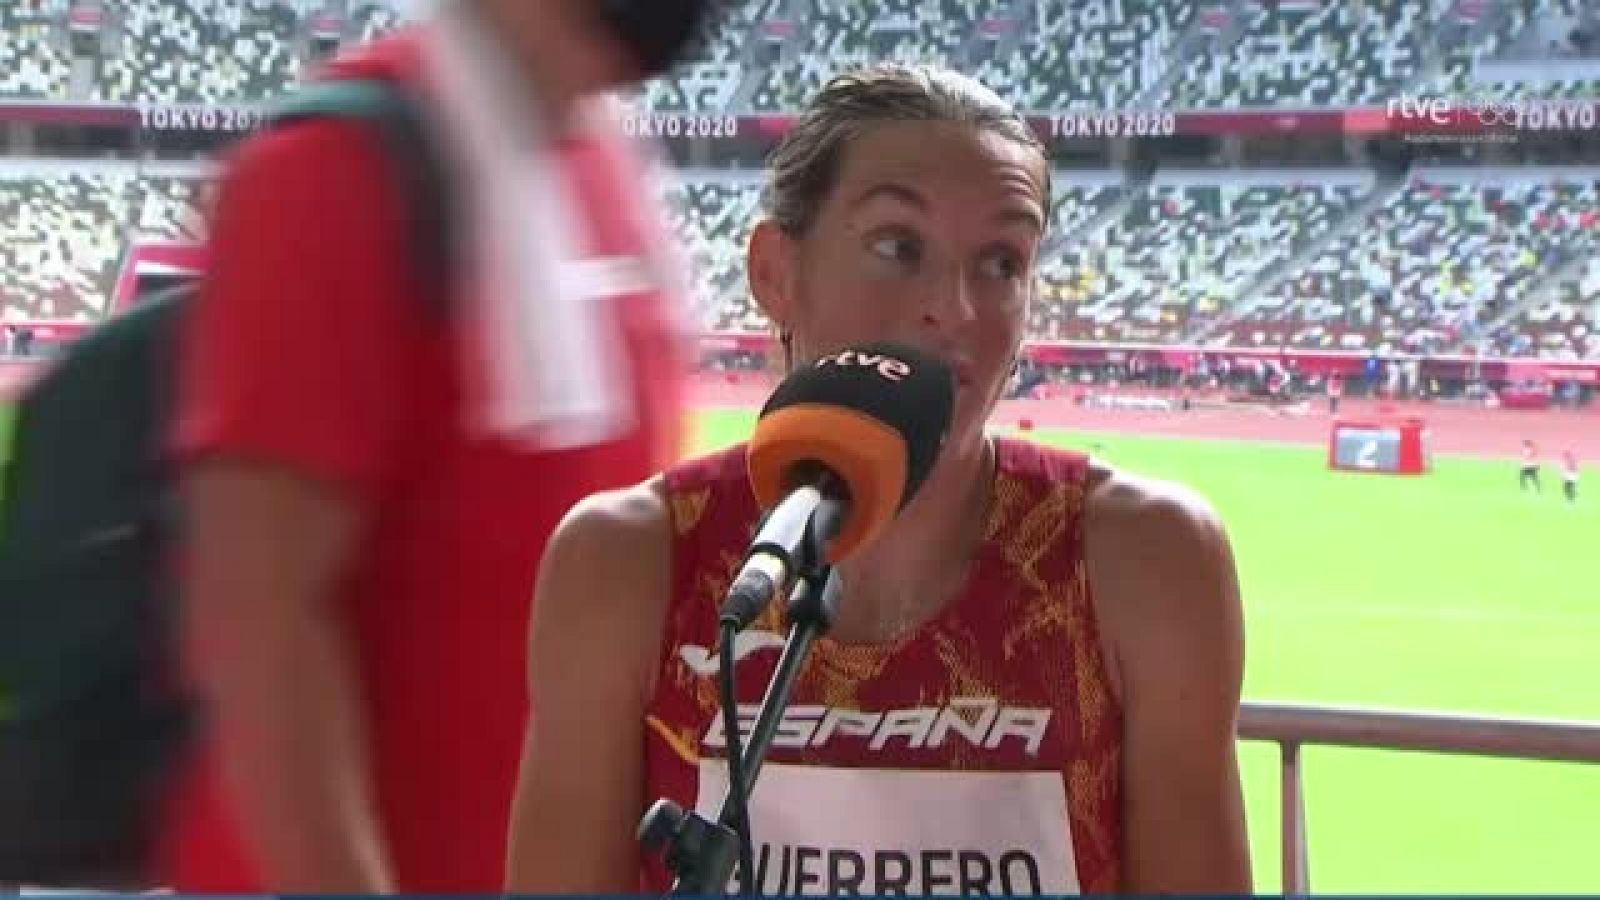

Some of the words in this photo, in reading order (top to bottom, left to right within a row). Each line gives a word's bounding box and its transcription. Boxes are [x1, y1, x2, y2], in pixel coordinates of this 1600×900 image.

[684, 113, 737, 138] 2020
[1050, 111, 1118, 137] TOKYO
[1122, 111, 1176, 137] 2020
[701, 698, 1052, 757] ESPAÑA
